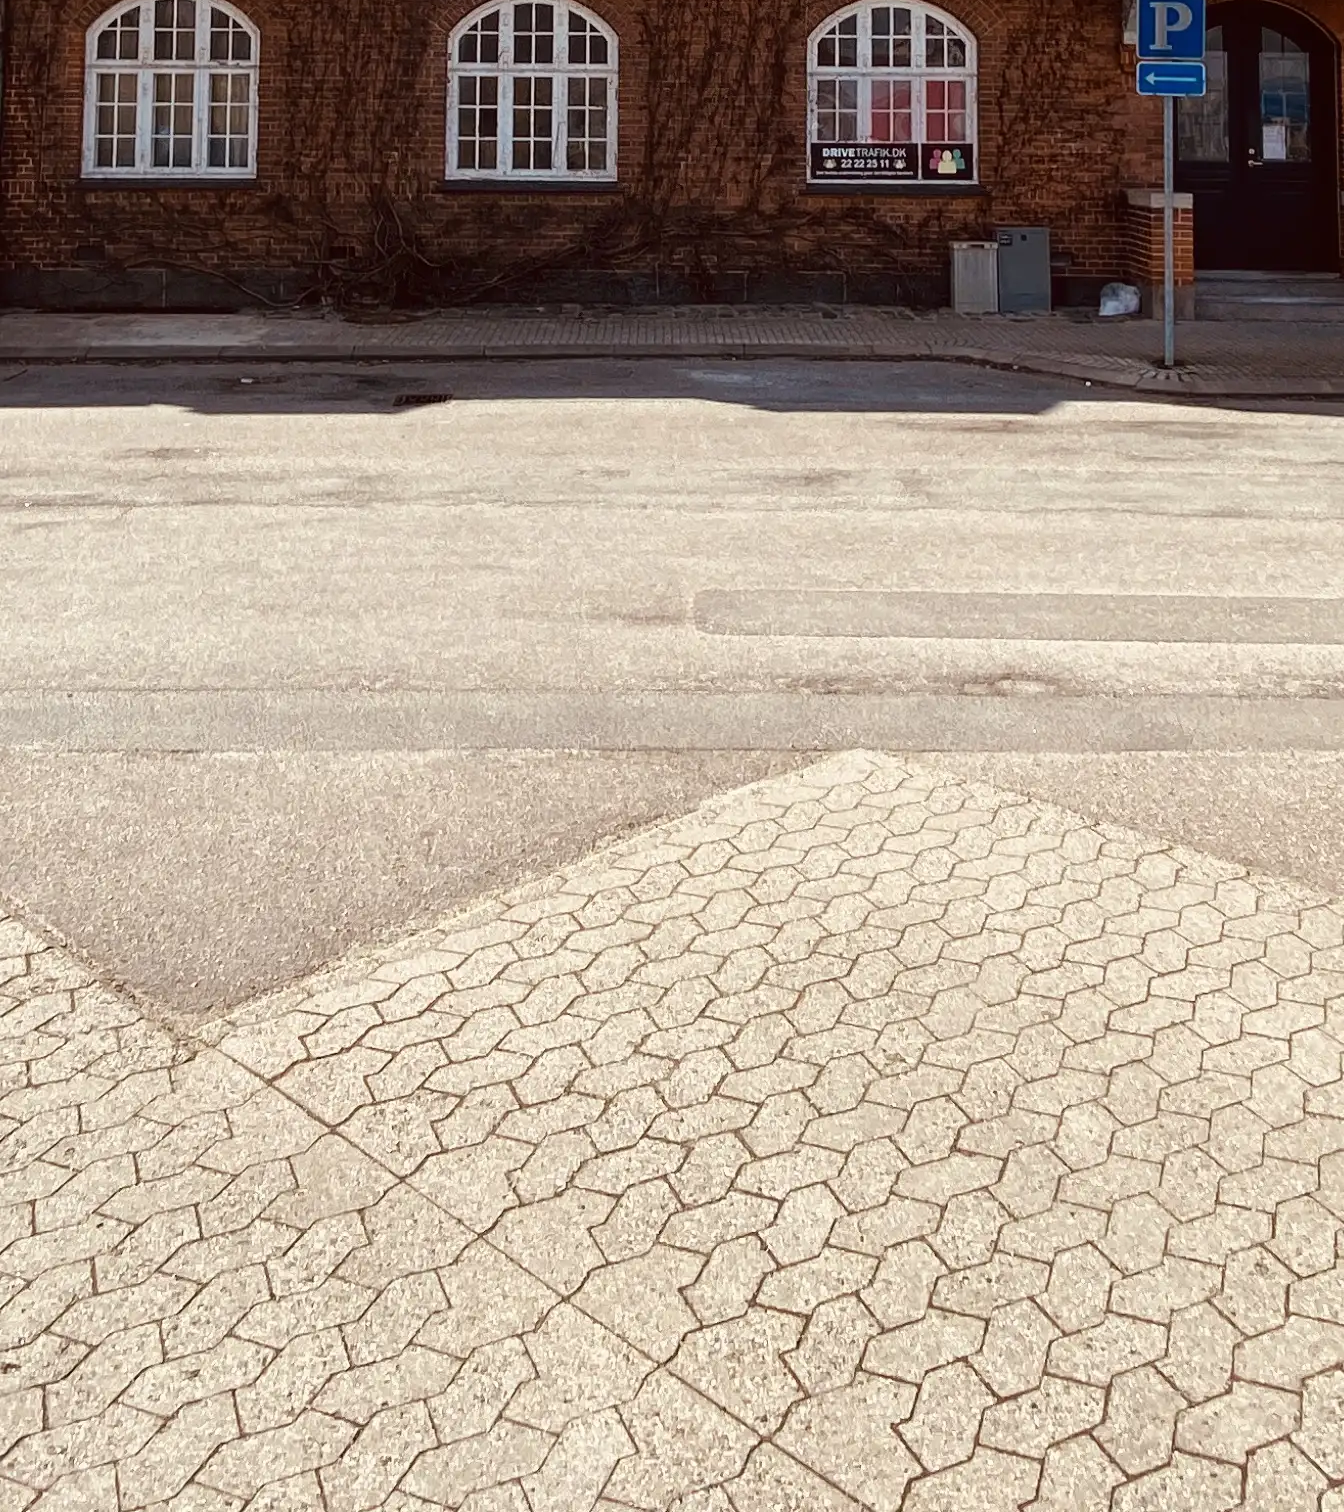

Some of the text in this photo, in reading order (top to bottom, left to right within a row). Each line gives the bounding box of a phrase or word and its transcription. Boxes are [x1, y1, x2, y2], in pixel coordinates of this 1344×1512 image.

[1149, 1, 1193, 50] P
[822, 147, 906, 157] DRIVETRAFIK.DK
[840, 159, 889, 168] 22 22 25 11
